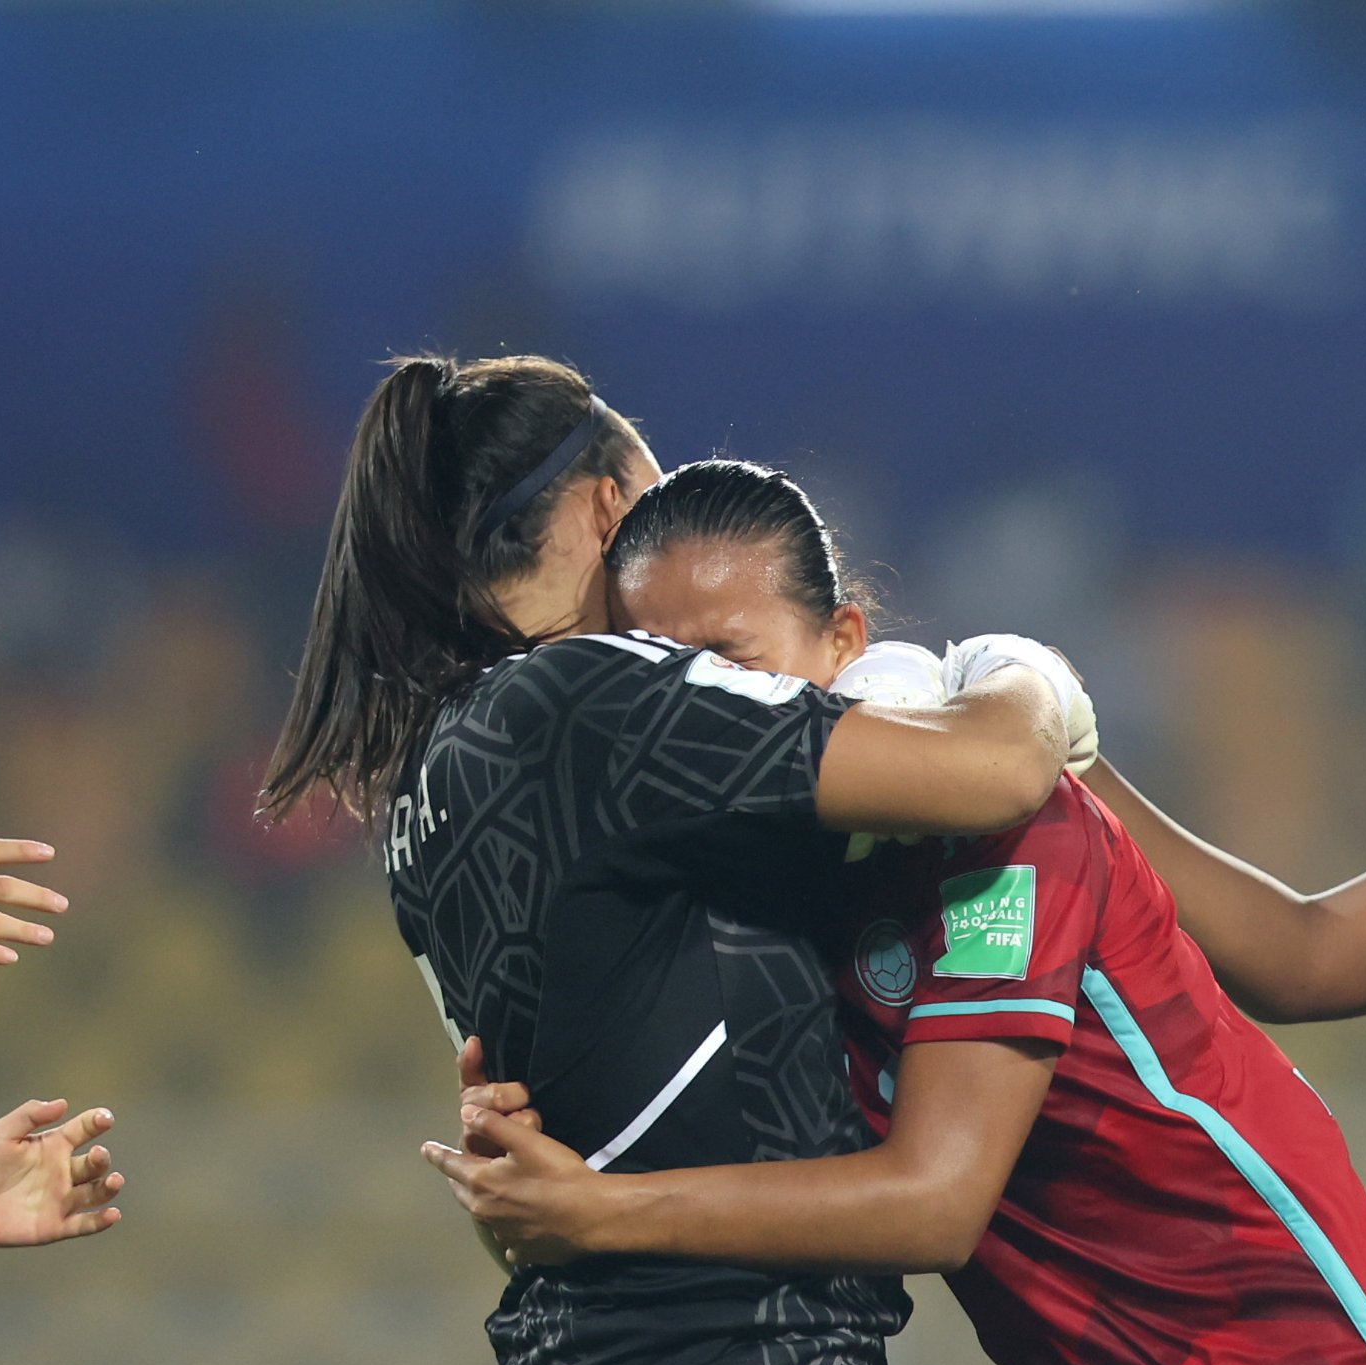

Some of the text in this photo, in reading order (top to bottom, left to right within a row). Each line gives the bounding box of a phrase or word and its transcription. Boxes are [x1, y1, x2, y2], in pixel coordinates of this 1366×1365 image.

[950, 897, 1026, 920] LIVING
[952, 909, 1024, 932] FOOTBALL
[986, 932, 1023, 947] FIFA
